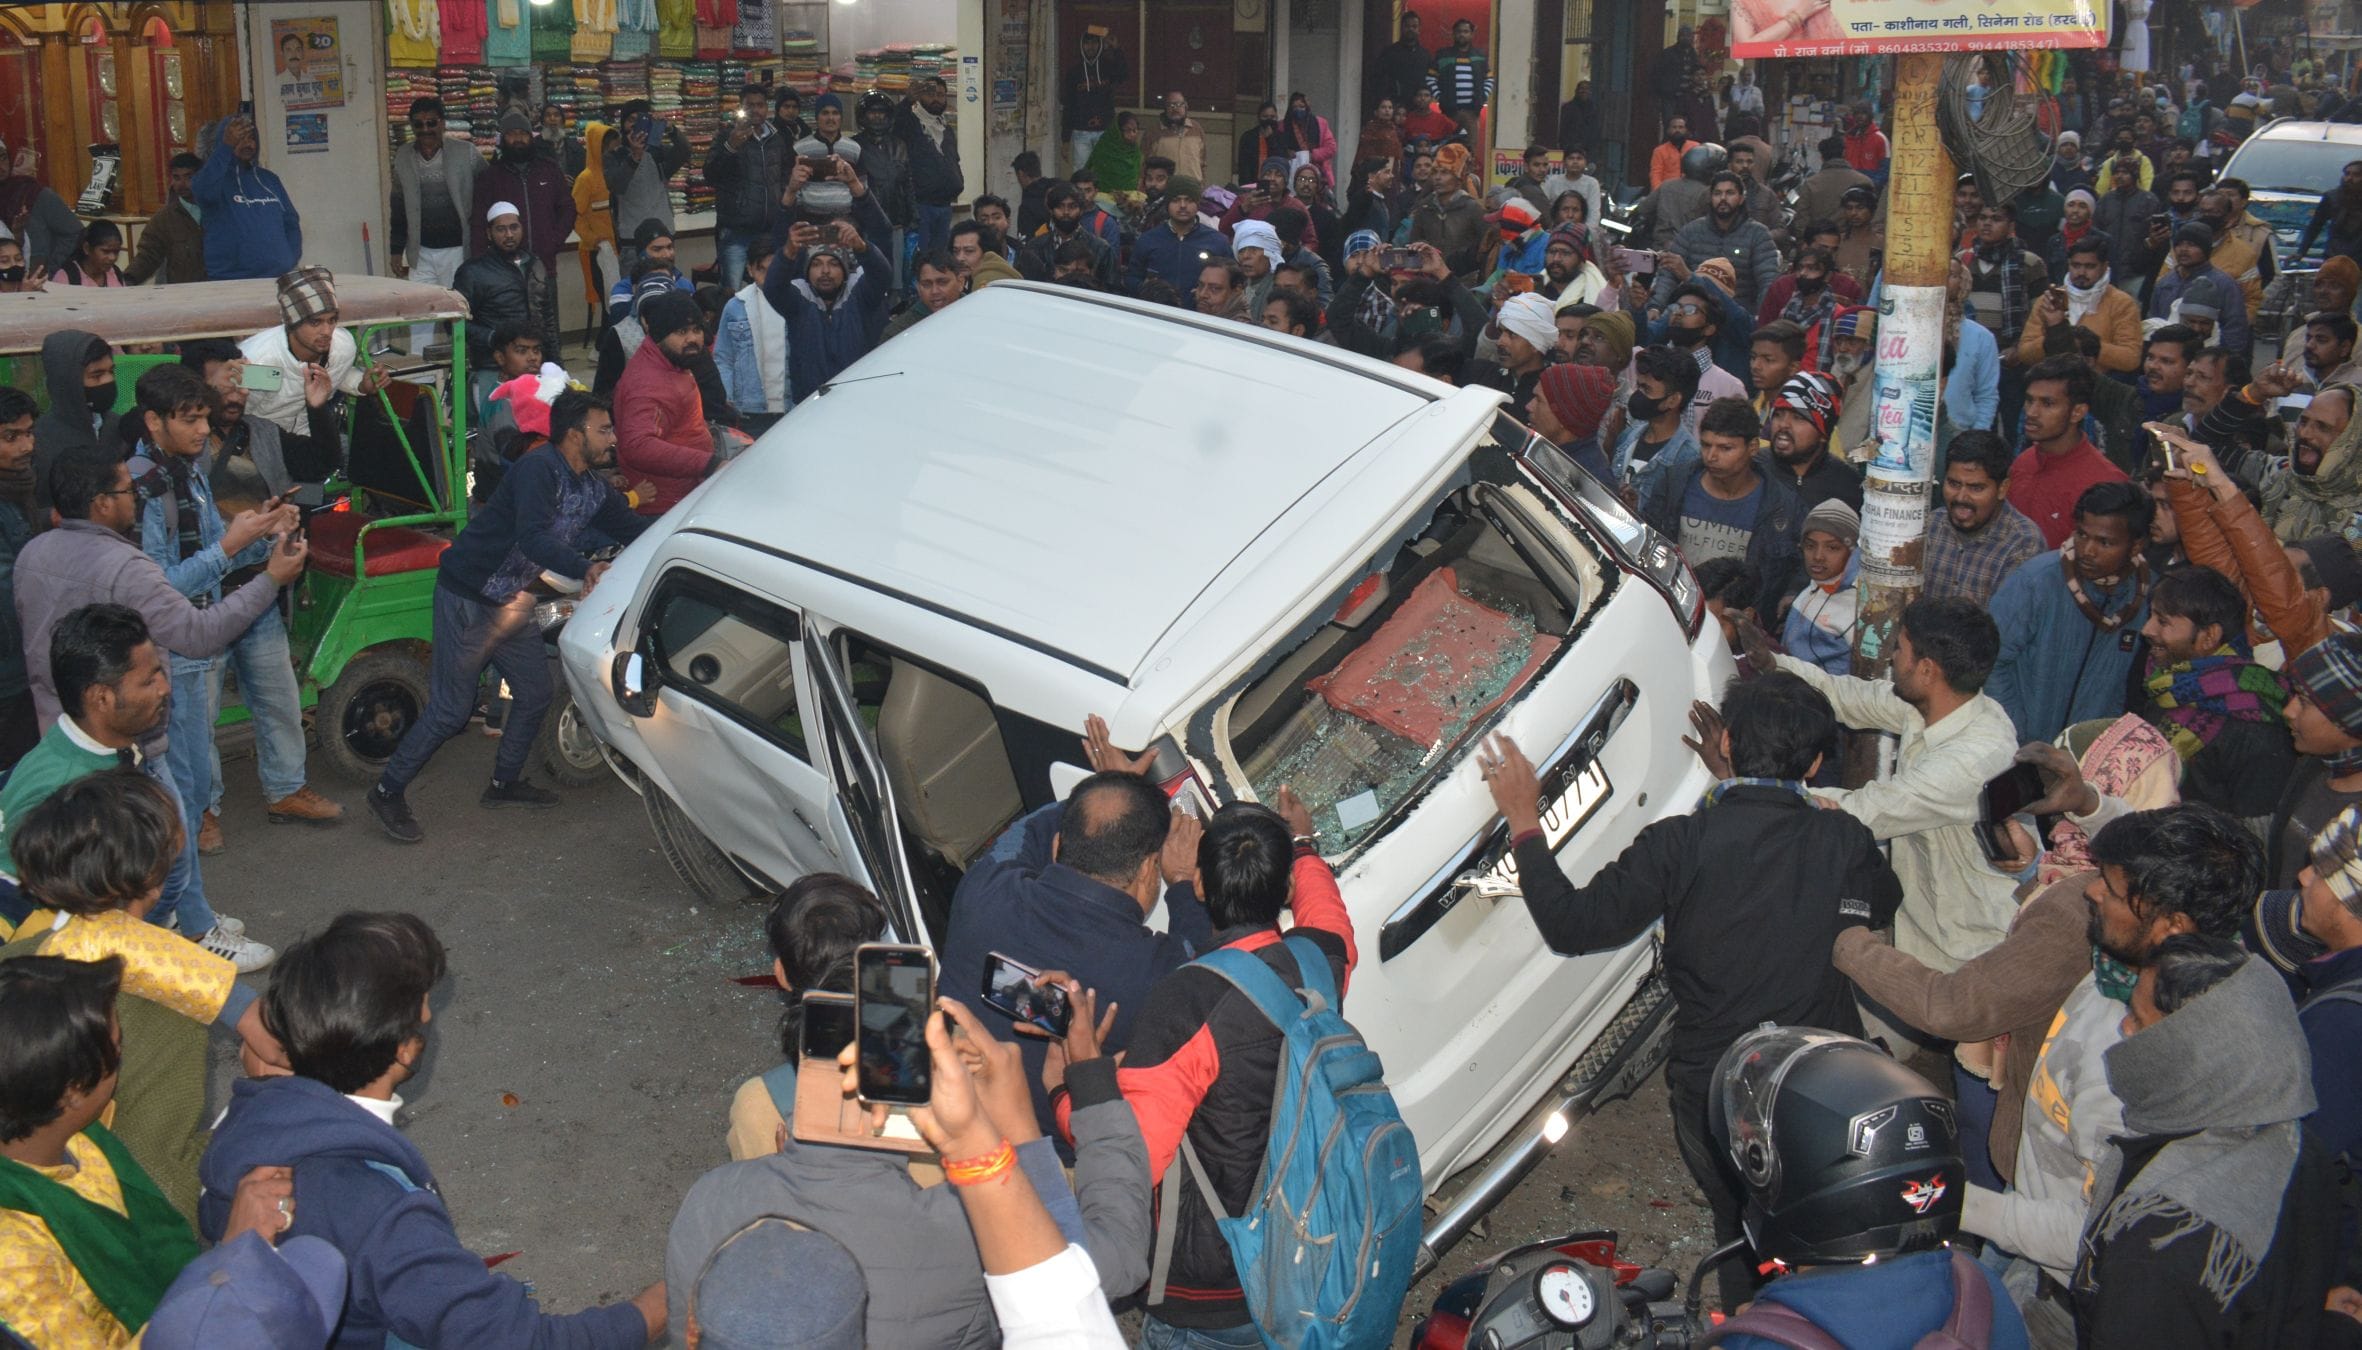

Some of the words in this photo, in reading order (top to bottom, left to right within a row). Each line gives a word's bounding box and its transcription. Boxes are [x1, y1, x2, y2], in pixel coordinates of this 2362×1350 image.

[1943, 14, 1973, 30] गली,
[1977, 13, 2019, 28] सिनेमा
[2023, 12, 2044, 26] रोड
[1879, 334, 1909, 361] ea
[1878, 404, 1904, 427] Tea
[1884, 507, 1922, 521] FINANCE
[1587, 730, 1606, 756] R
